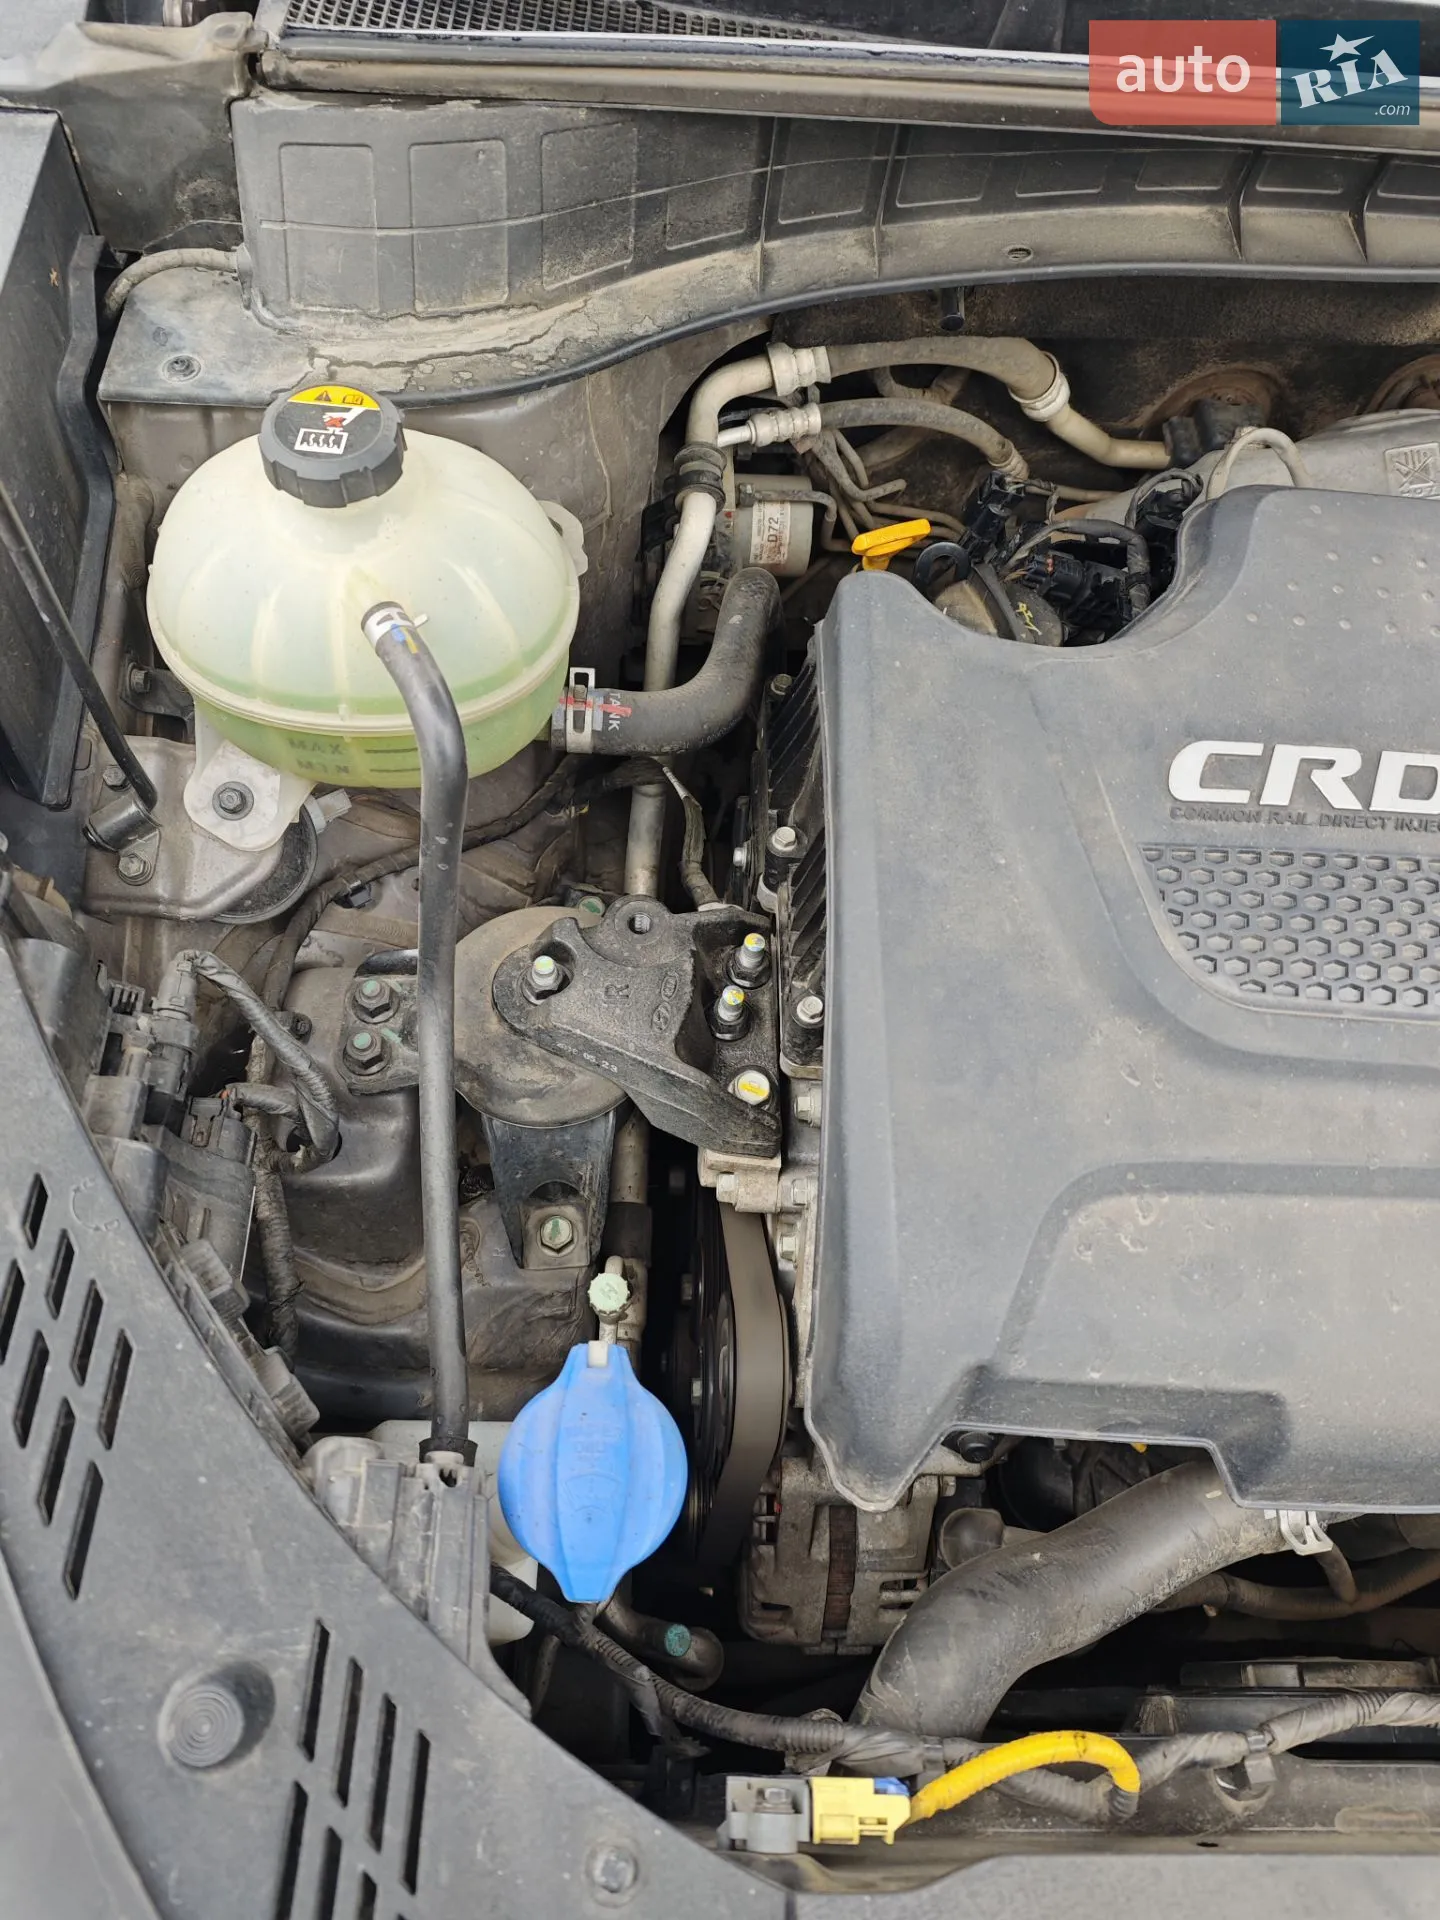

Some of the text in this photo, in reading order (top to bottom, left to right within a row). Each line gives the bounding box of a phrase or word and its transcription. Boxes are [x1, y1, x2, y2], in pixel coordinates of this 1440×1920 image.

[767, 516, 779, 543] D72
[1168, 740, 1440, 815] CRD
[1169, 806, 1262, 823] COMMON
[1268, 811, 1312, 826] RAIL
[1319, 812, 1391, 830] DIRECT
[604, 984, 629, 1000] R
